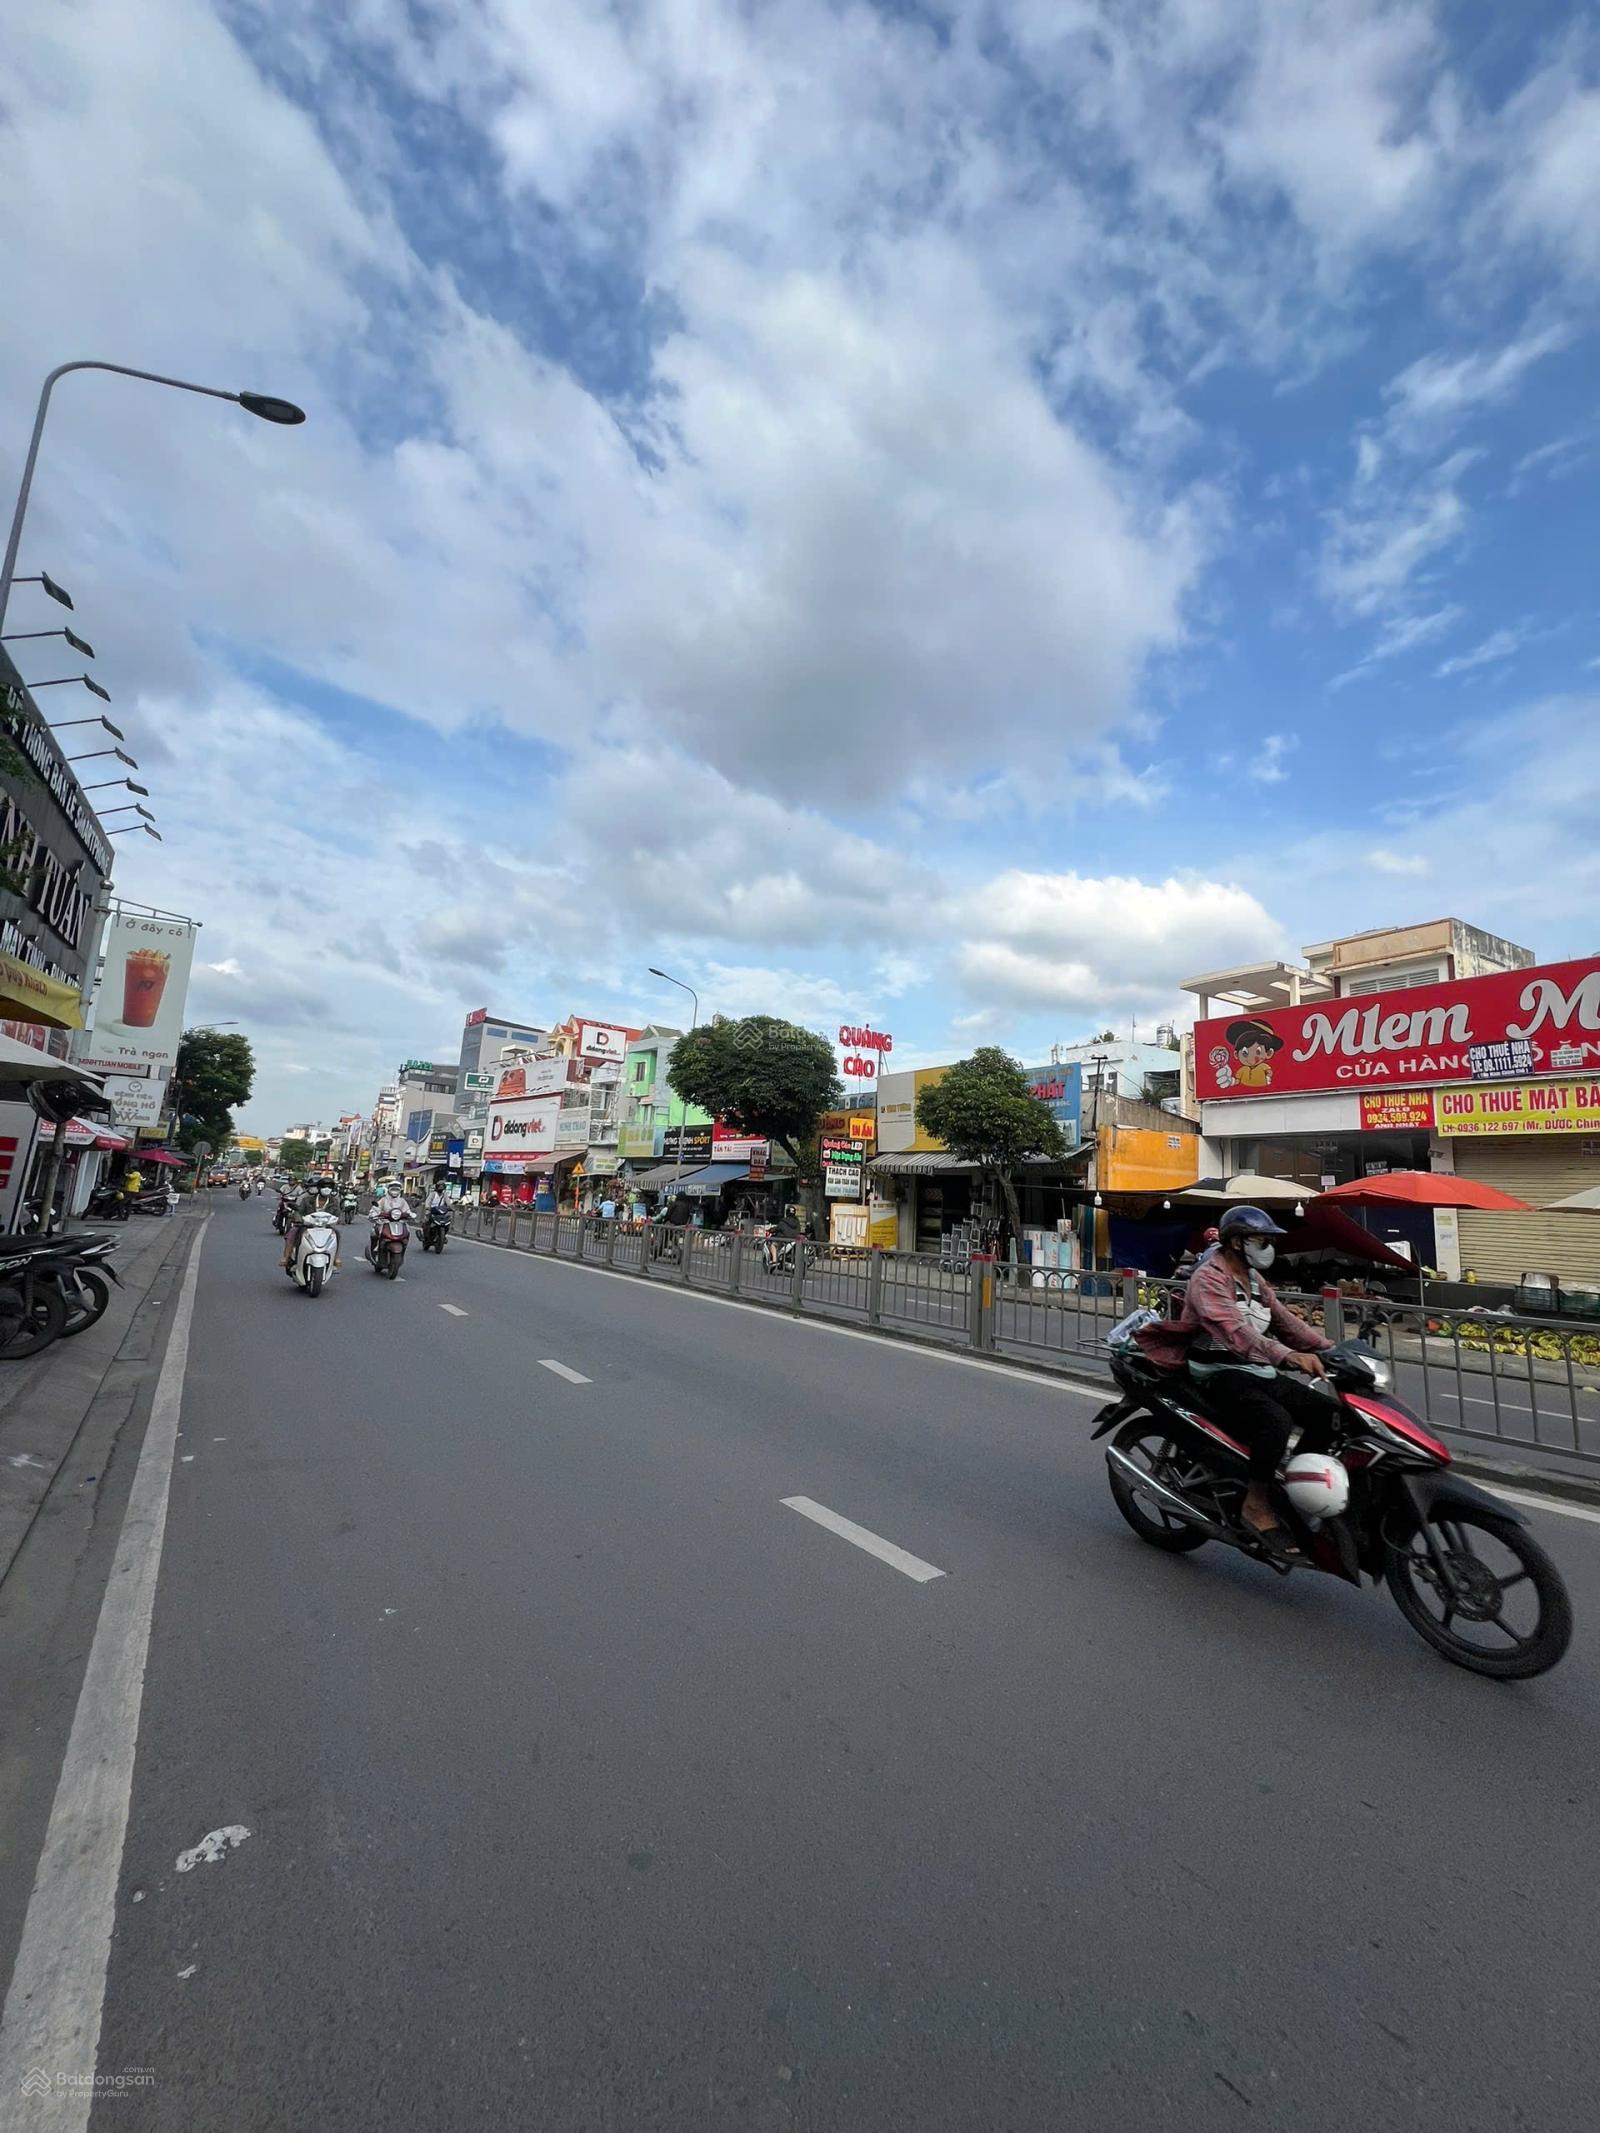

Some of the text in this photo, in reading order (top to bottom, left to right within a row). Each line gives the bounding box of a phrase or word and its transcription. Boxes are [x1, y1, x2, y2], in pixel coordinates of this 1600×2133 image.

[22, 722, 52, 780] THỐNG
[36, 848, 91, 953] TUẤN
[168, 927, 183, 937] có
[839, 1023, 893, 1052] QUẢNG
[1292, 1002, 1474, 1062] Mlem
[118, 1046, 169, 1059] Trà ngon
[1469, 1046, 1488, 1061] CHO
[843, 1052, 875, 1078] CÁO
[1336, 1058, 1390, 1079] CỬA
[1029, 1078, 1065, 1099] PHÁT
[1363, 1095, 1381, 1109] CHO
[1442, 1093, 1474, 1115] CHO
[1479, 1086, 1523, 1113] THUÊ
[1528, 1082, 1569, 1114] MẶT
[1366, 1110, 1427, 1124] 0934.509.924
[1381, 1106, 1410, 1114] ZALO
[1457, 1122, 1480, 1132] 0936
[1483, 1122, 1499, 1132] 122
[1502, 1121, 1519, 1131] 697
[694, 1135, 711, 1145] SPORT
